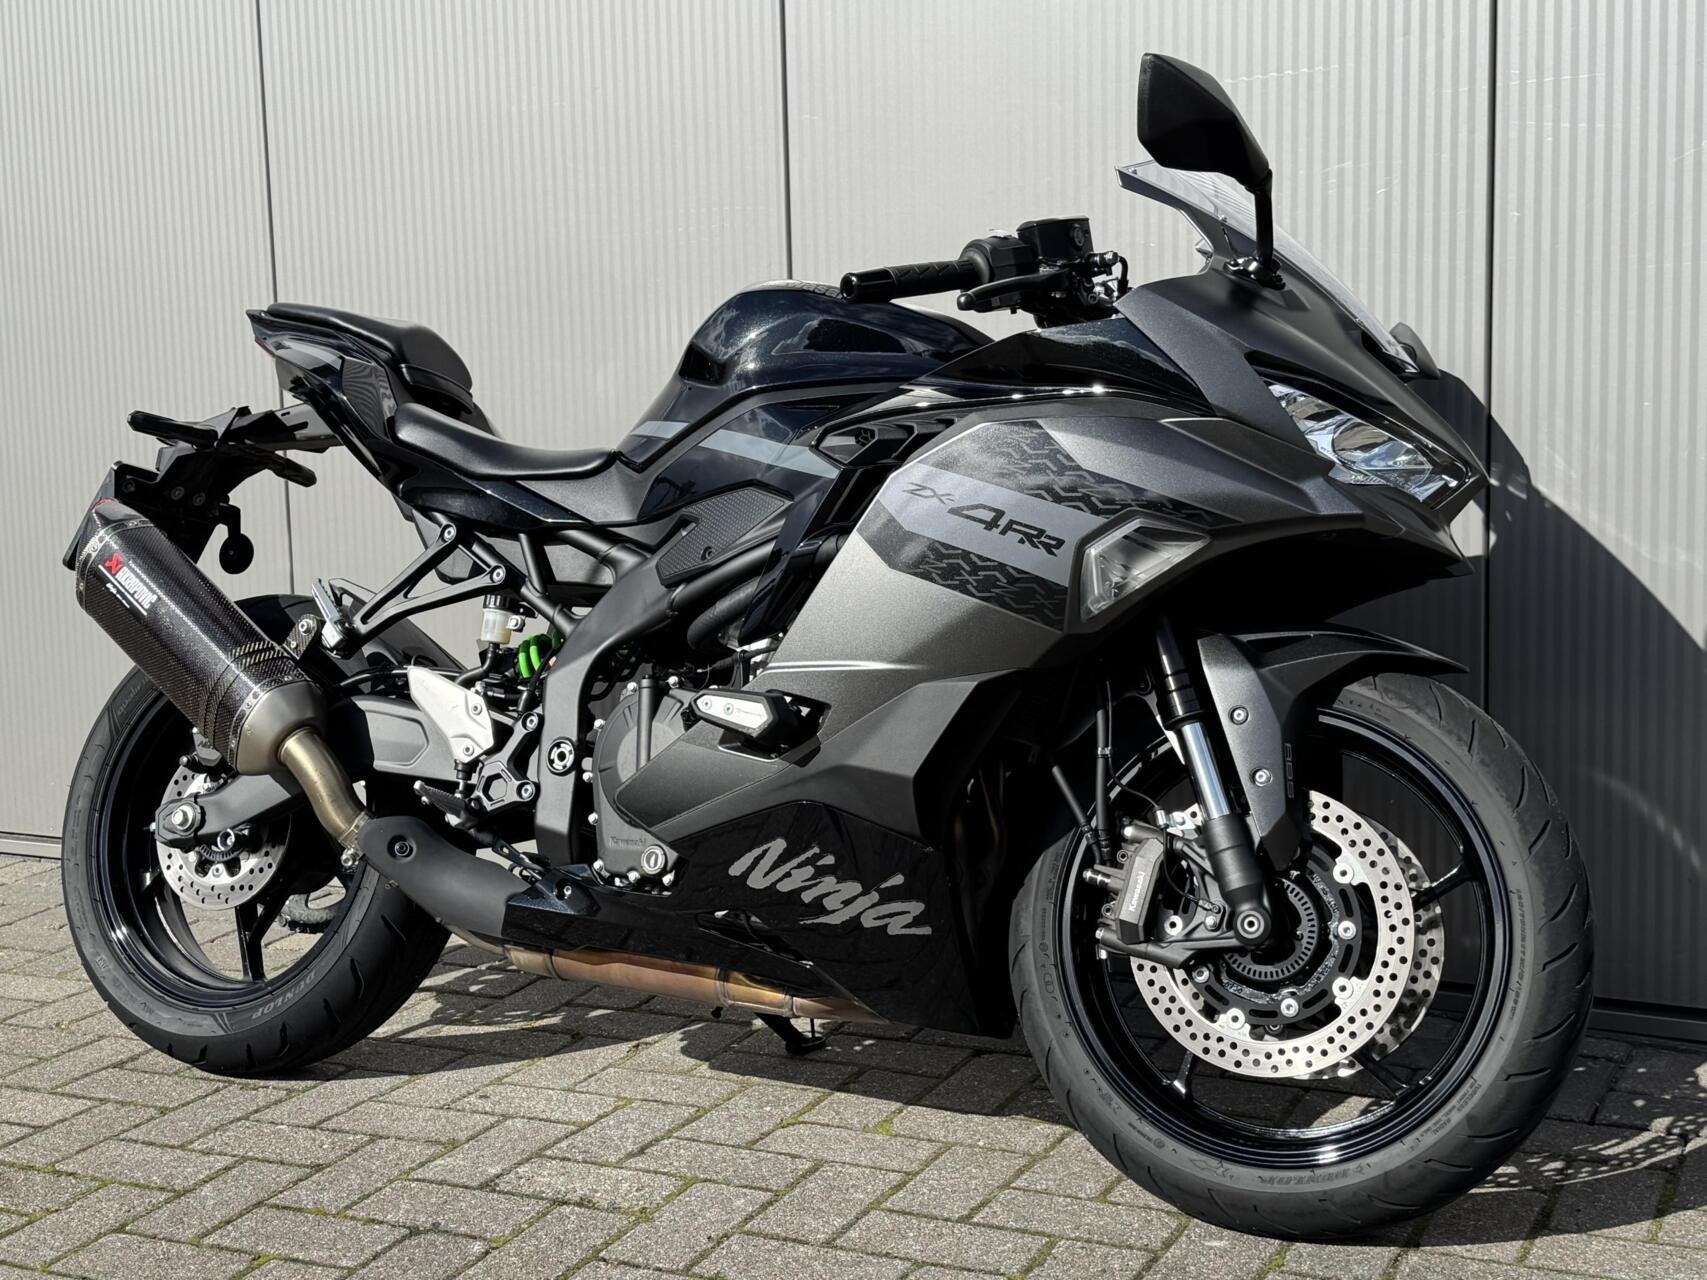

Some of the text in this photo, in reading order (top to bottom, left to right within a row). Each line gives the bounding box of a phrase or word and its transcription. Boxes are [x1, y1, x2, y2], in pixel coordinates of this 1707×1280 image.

[728, 838, 932, 935] Ninja
[1128, 871, 1146, 912] Kawasaki
[251, 969, 316, 1020] DUNLOP
